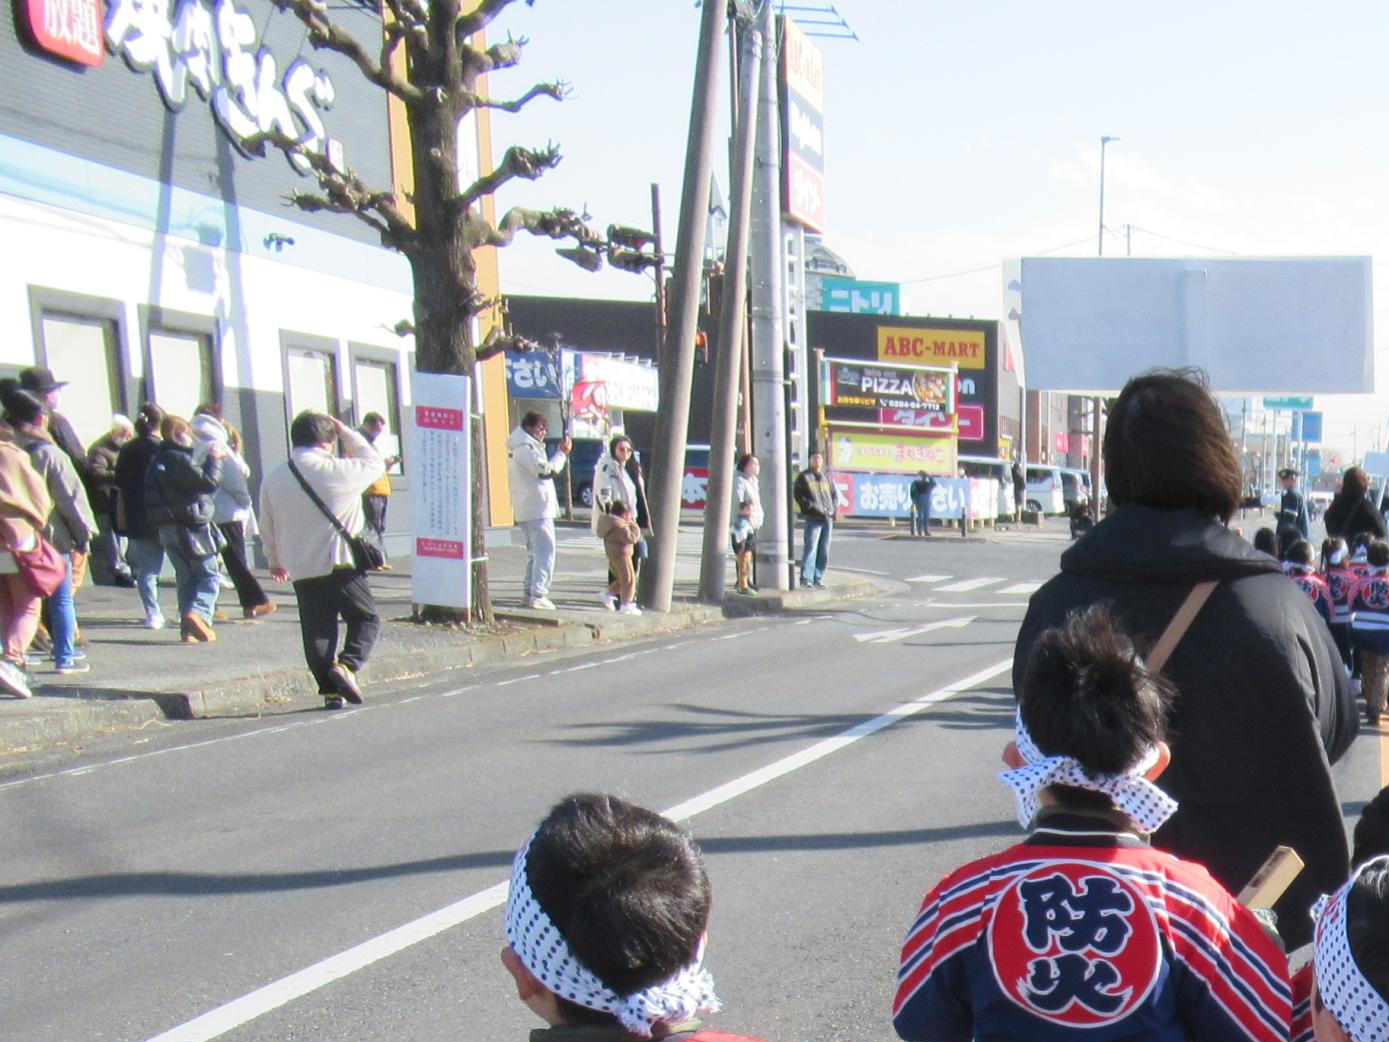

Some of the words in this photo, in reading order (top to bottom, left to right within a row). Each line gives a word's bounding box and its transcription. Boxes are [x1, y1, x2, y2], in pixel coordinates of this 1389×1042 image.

[829, 288, 893, 313] ニトリ
[883, 335, 980, 359] ABC-MART
[506, 356, 557, 390] さい
[861, 375, 914, 396] PIZZA
[859, 480, 965, 514] お売りさい
